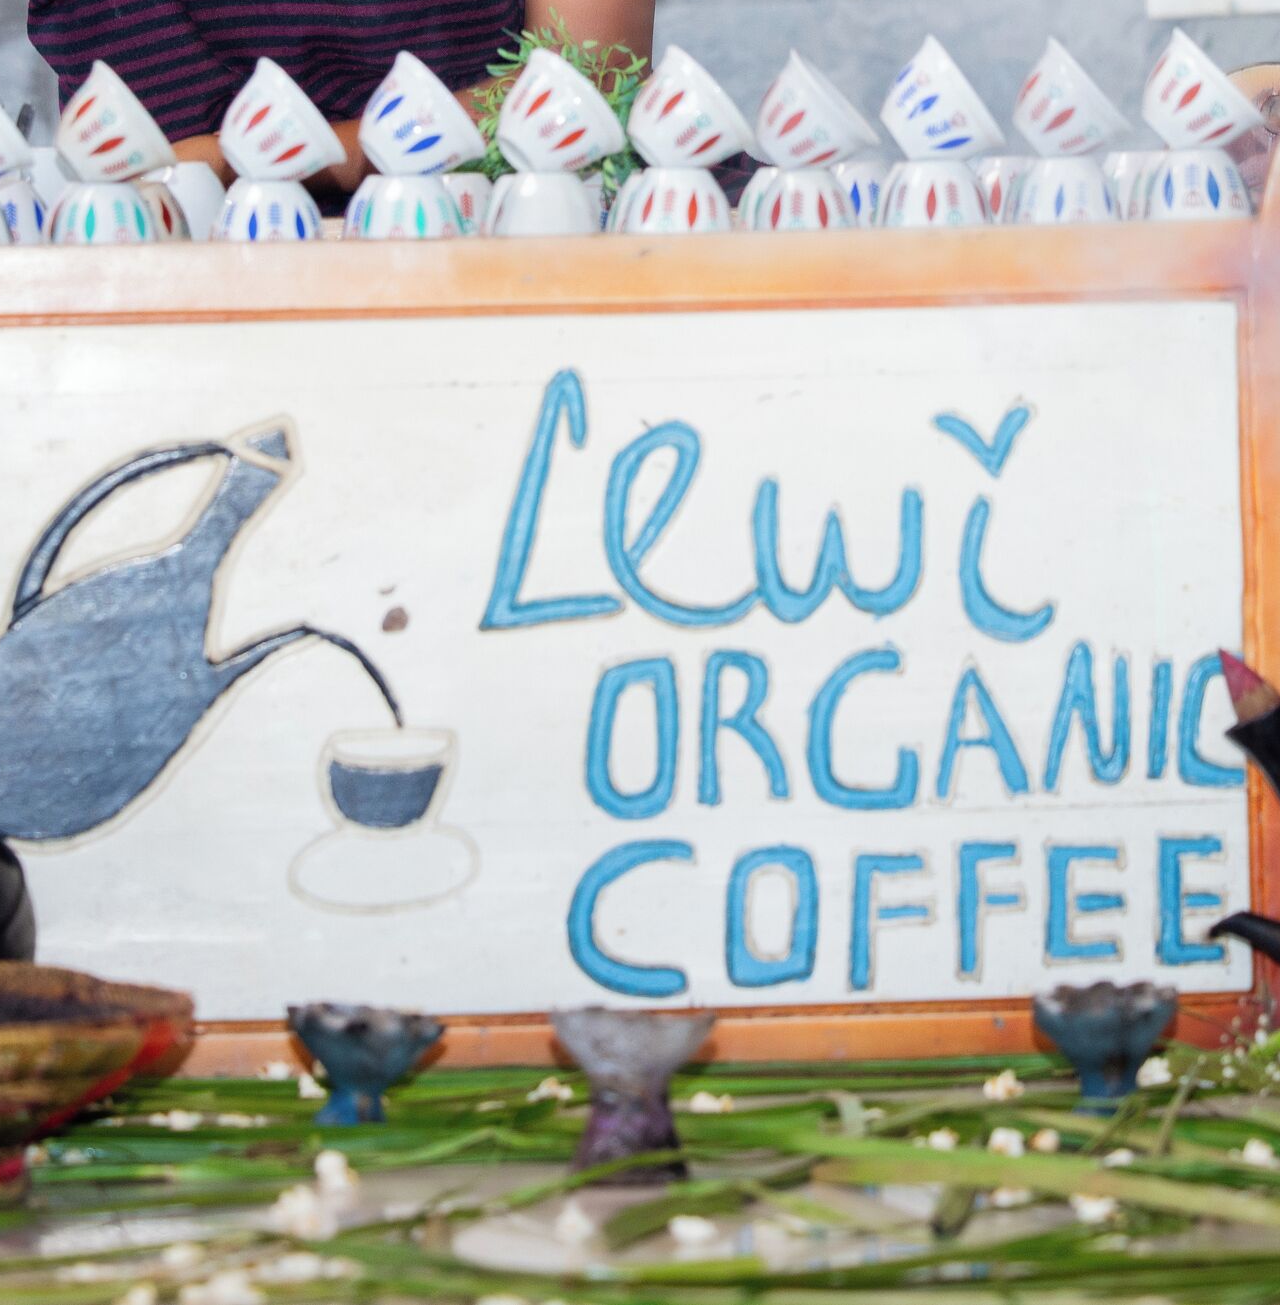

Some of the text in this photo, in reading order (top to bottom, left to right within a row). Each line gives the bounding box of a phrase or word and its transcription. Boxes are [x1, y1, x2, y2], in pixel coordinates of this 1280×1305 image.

[480, 368, 1057, 642] Lewi
[586, 641, 1245, 820] ORGANIC
[567, 835, 1231, 998] COFFEE
